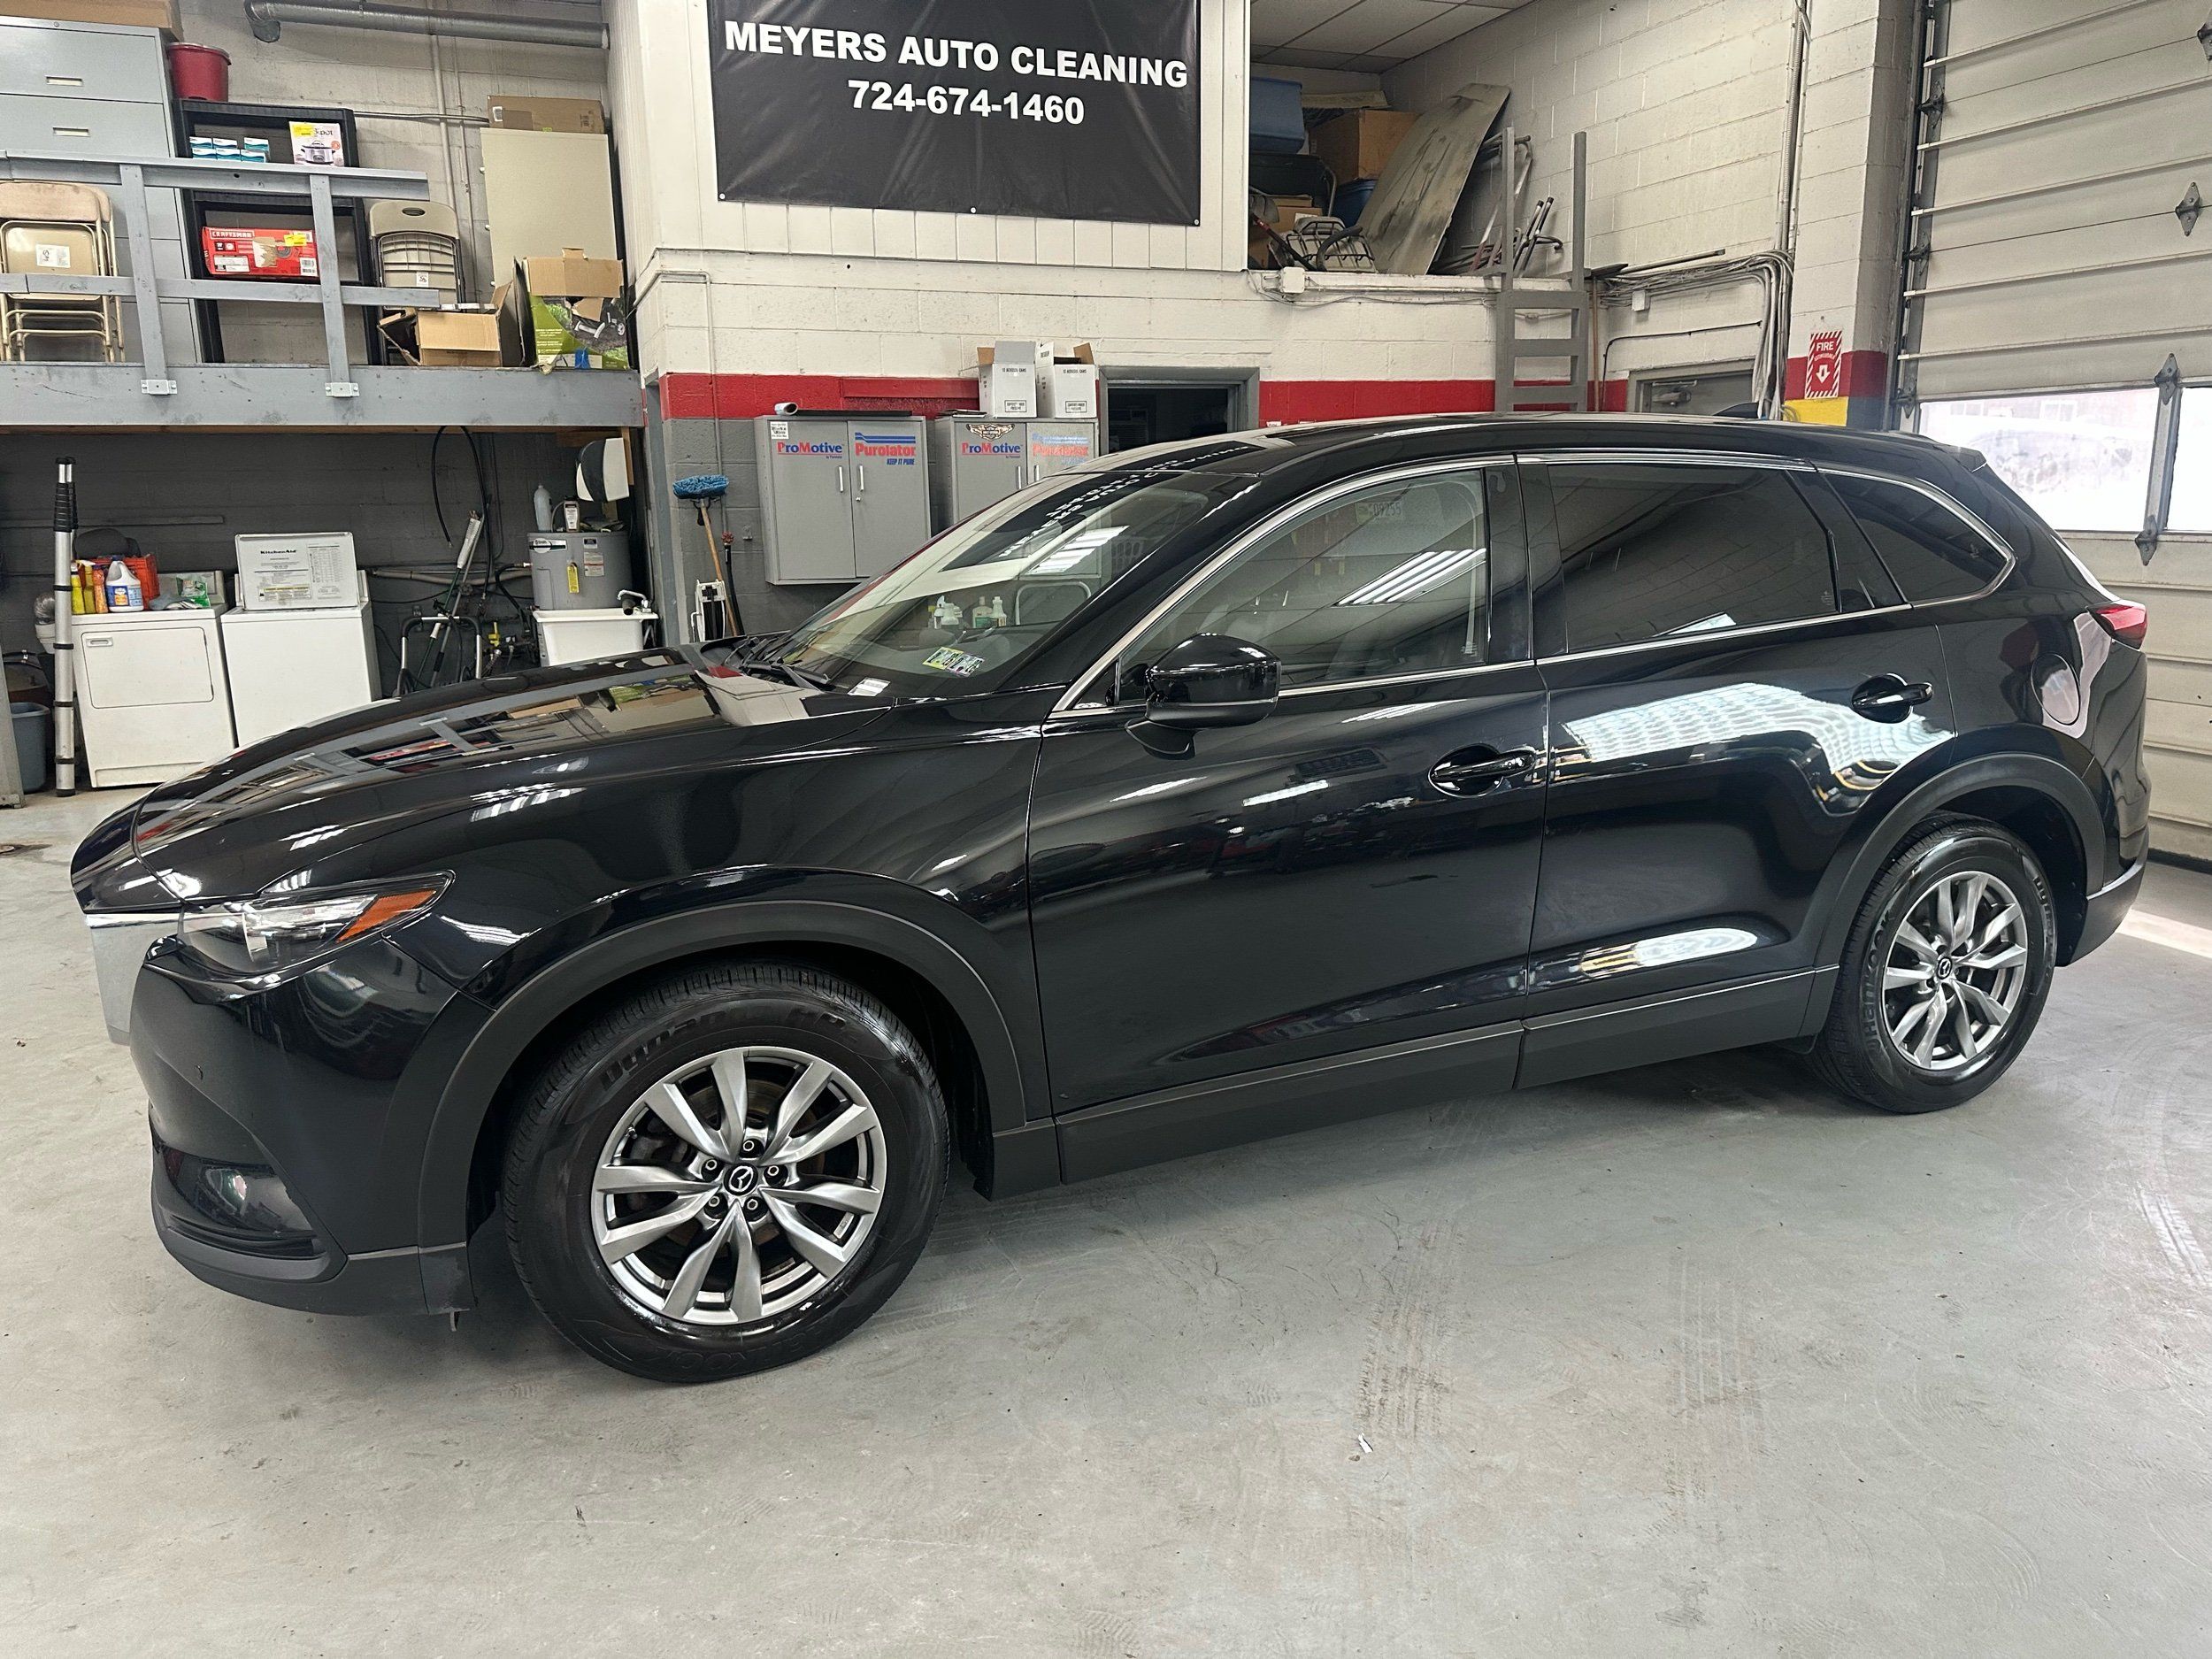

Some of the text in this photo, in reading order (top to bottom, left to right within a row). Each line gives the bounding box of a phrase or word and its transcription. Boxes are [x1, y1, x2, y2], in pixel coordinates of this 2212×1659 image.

[725, 19, 1188, 88] MEYERS AUTO CLEANING
[848, 80, 1085, 125] 724-674-1460
[1816, 341, 1835, 352] FIRE
[777, 442, 842, 453] ProMotive
[855, 443, 916, 457] Purolator
[962, 442, 1021, 454] ProMotive
